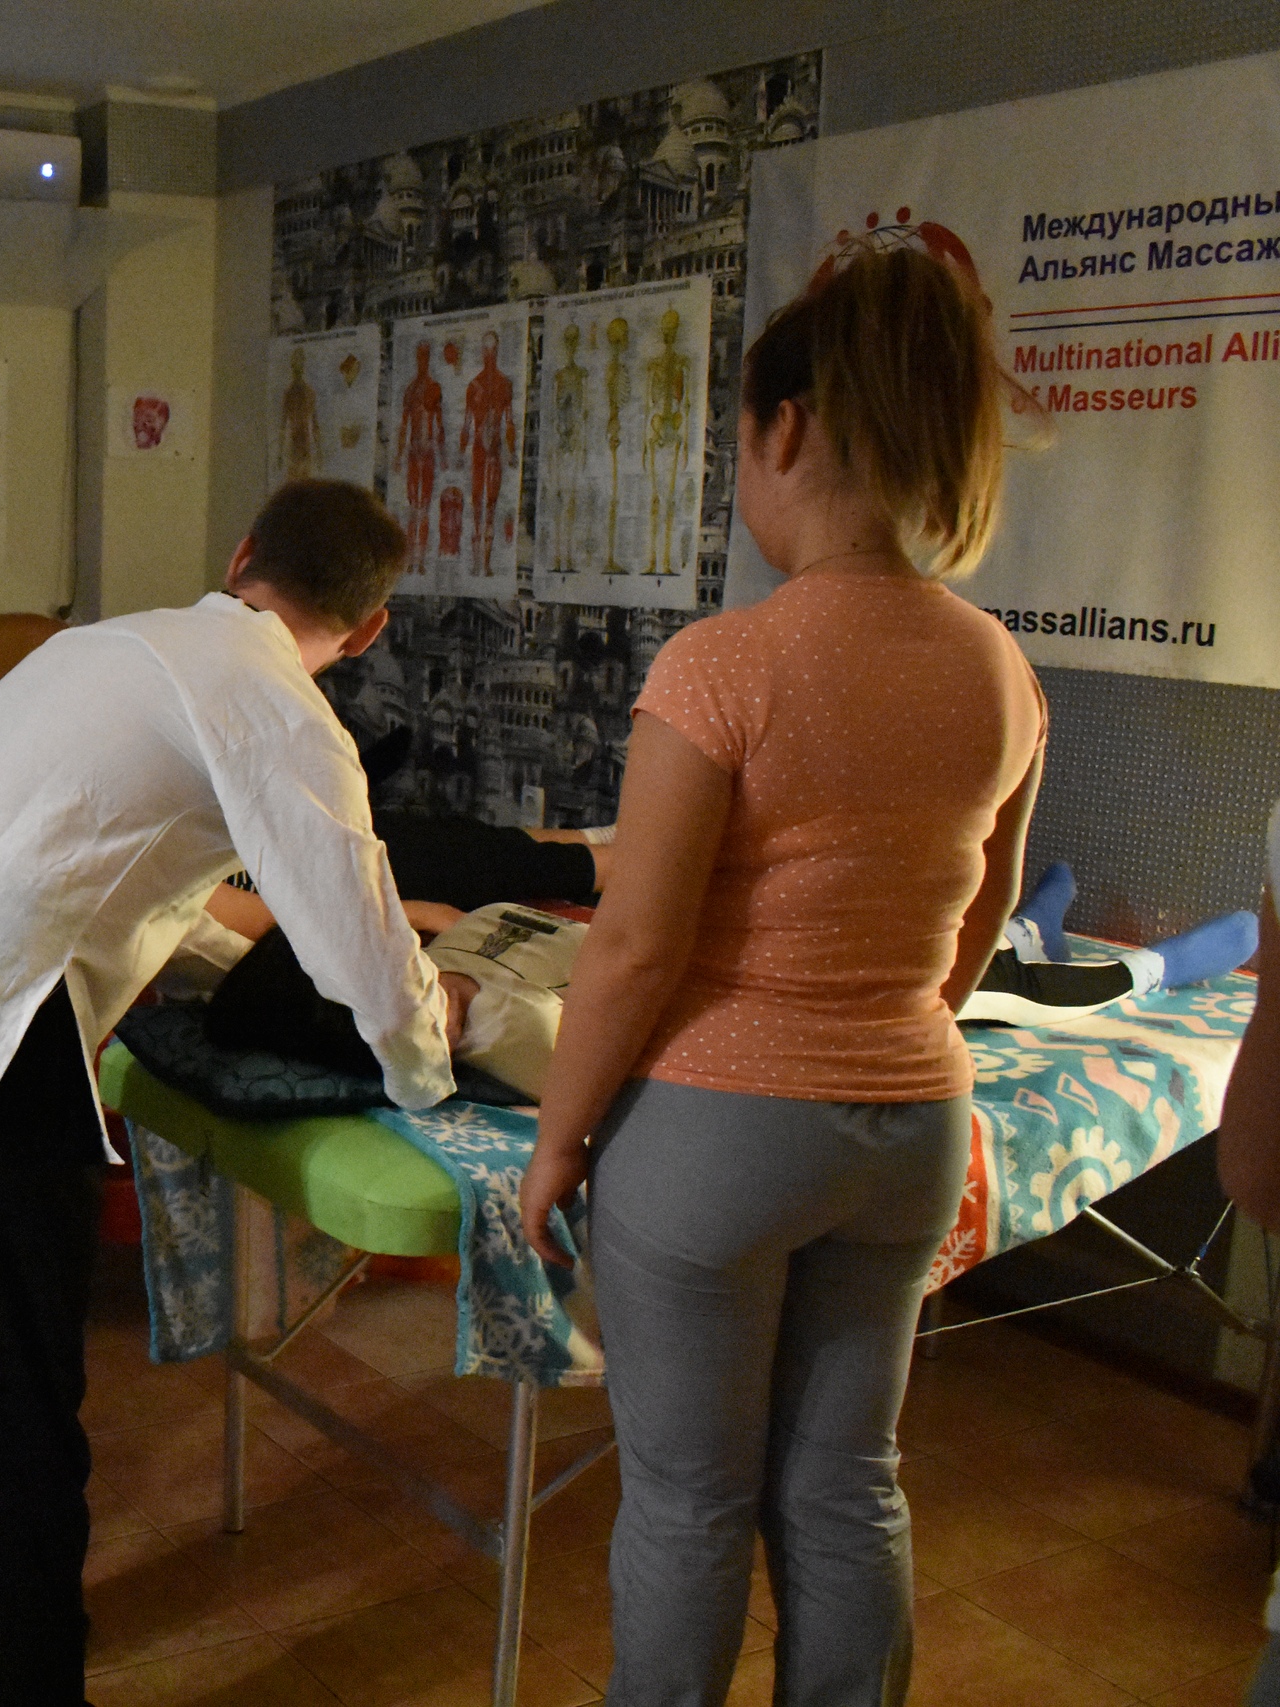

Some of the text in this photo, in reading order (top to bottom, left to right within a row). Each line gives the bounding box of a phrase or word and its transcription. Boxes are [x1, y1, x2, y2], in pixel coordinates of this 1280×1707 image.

[1018, 237, 1280, 283] Альянс Массаж
[1013, 329, 1280, 373] Multinational Alli
[1048, 384, 1197, 412] Masseurs
